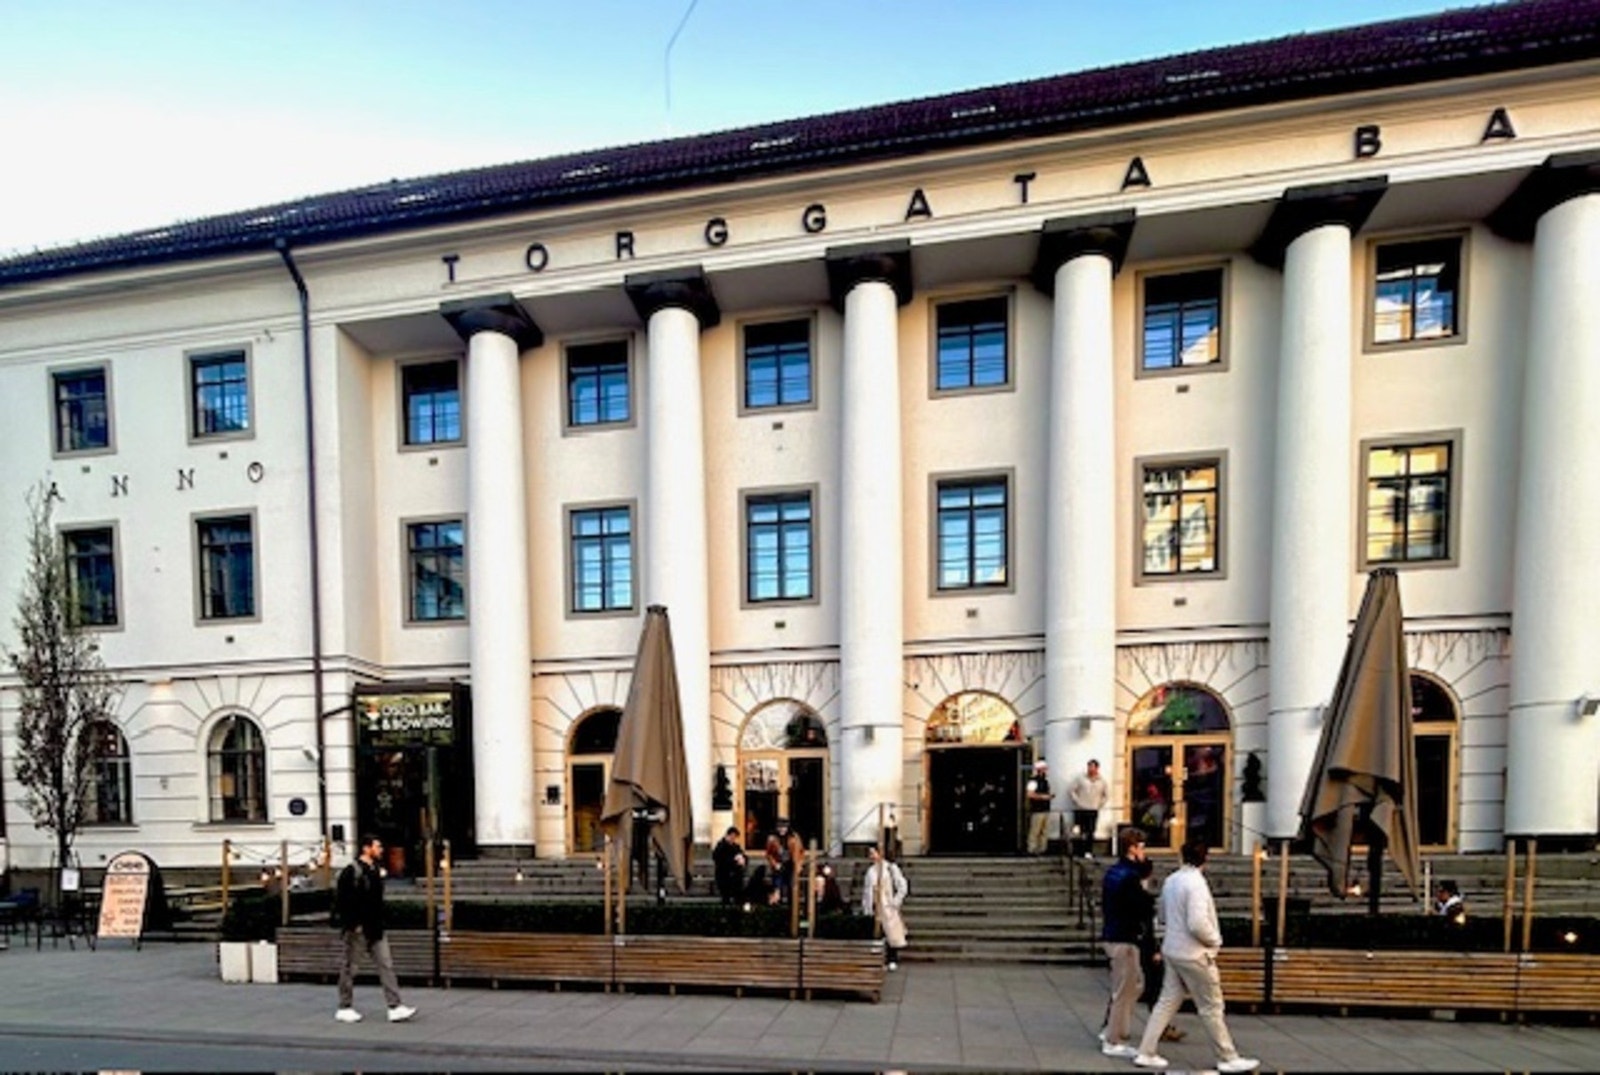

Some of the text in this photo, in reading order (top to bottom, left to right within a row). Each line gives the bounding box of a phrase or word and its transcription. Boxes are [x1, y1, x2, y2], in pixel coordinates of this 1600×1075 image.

[442, 107, 1517, 284] TORGGATA BA
[44, 461, 265, 504] ANNO
[382, 705, 416, 716] OSLO
